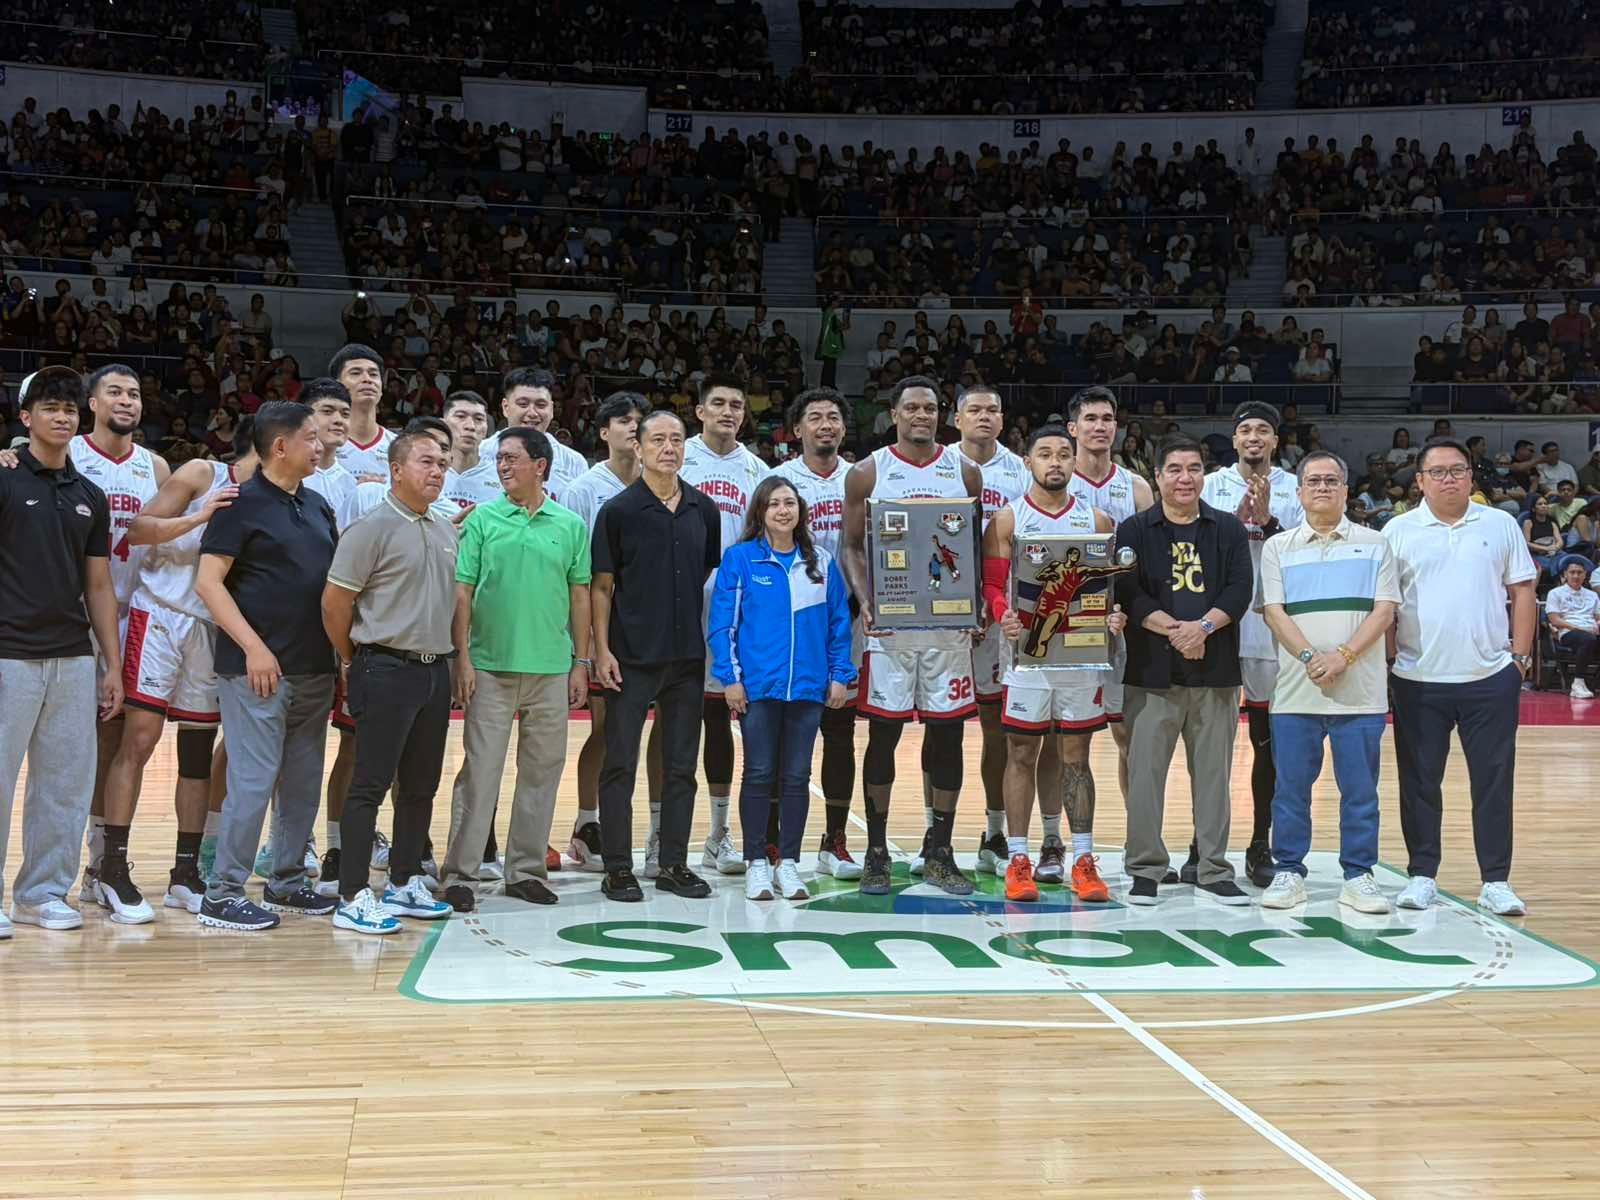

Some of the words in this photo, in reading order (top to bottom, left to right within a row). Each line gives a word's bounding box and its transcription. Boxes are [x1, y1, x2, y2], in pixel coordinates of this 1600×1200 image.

[667, 116, 690, 129] 217
[1015, 122, 1039, 135] 218
[694, 480, 747, 511] INEBRA
[948, 676, 972, 701] 32
[1092, 684, 1104, 708] 4
[556, 916, 1478, 973] smart
